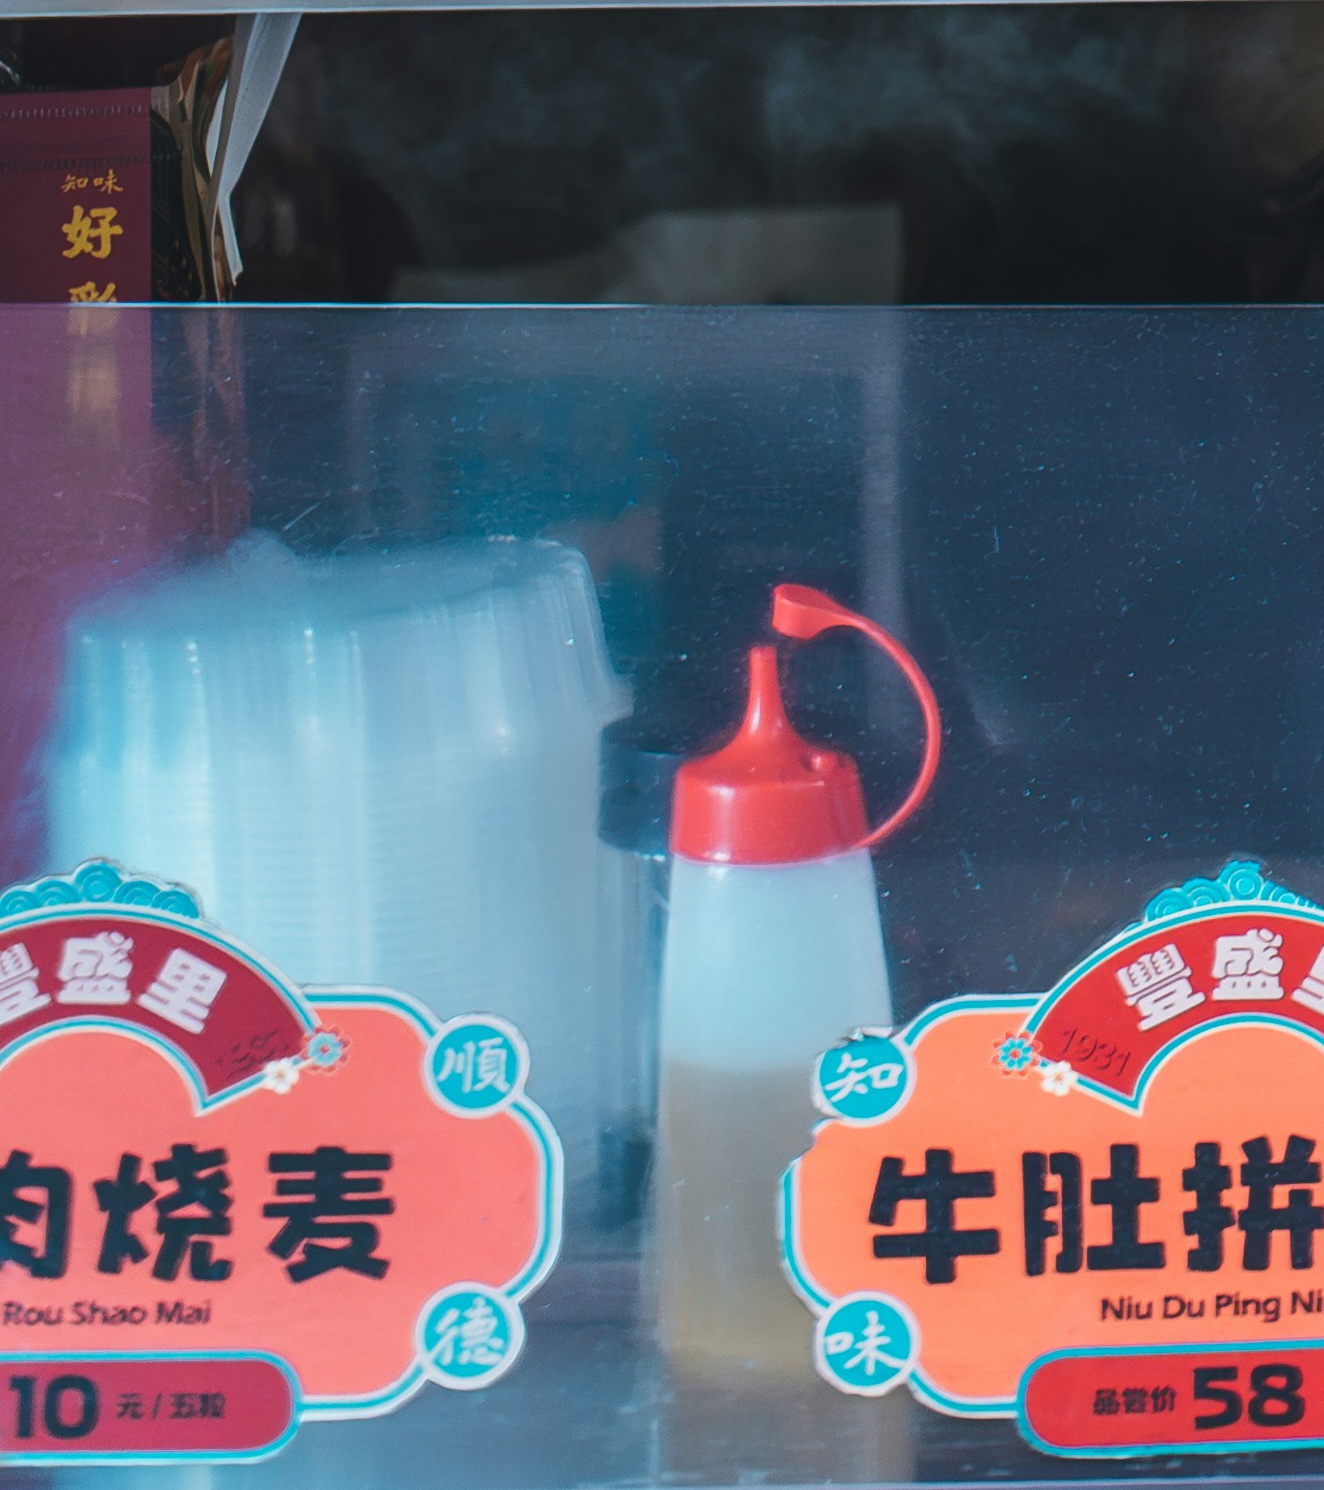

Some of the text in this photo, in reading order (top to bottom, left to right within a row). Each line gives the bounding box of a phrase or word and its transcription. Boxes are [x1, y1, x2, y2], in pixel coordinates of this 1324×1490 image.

[61, 169, 124, 194] 知味
[437, 1038, 511, 1094] 順
[824, 1050, 903, 1106] 知
[73, 1302, 147, 1326] Shao
[156, 1301, 210, 1325] Mai
[434, 1297, 504, 1367] 德
[1101, 1298, 1153, 1320] Niu
[1162, 1296, 1205, 1320] Du
[1215, 1294, 1281, 1323] Ping
[825, 1310, 907, 1377] 味
[9, 1374, 99, 1439] 10
[1193, 1363, 1305, 1430] 58
